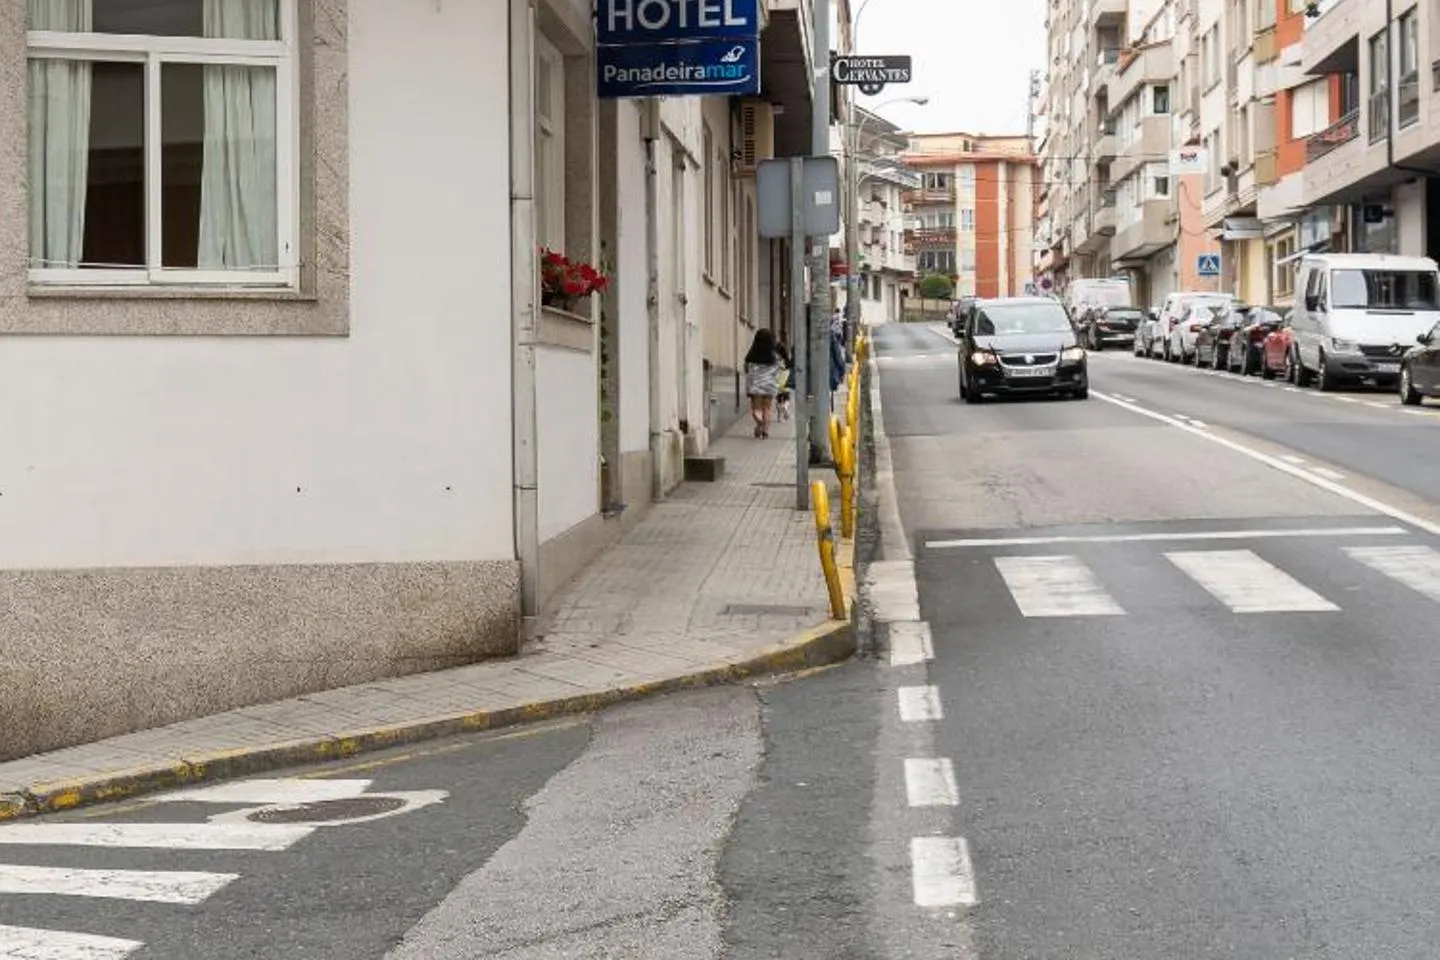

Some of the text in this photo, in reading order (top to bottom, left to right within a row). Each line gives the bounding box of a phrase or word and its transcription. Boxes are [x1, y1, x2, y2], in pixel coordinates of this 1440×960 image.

[603, 63, 747, 82] Panadeiramar
[833, 59, 909, 81] CERVANTES
[849, 59, 886, 68] HOTEL
